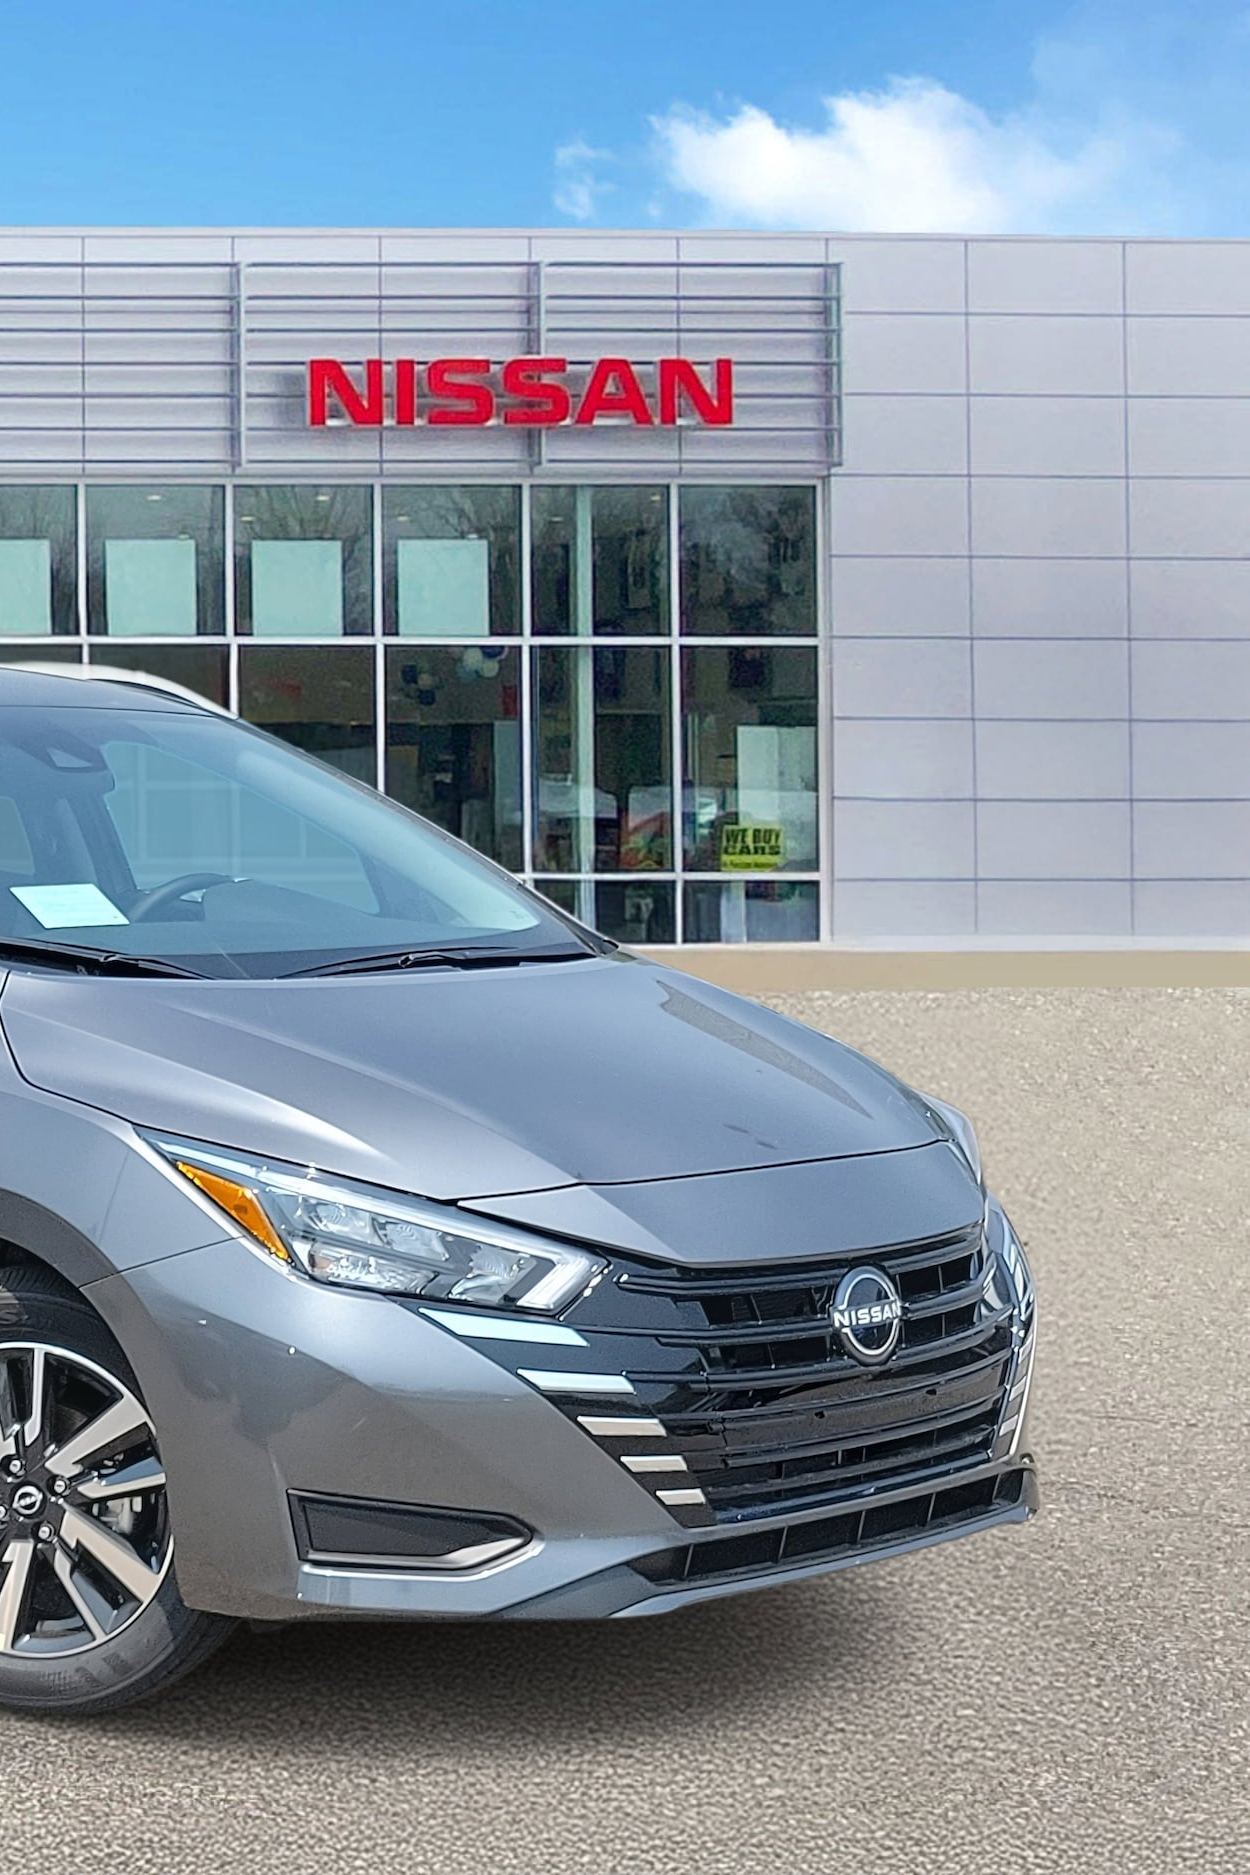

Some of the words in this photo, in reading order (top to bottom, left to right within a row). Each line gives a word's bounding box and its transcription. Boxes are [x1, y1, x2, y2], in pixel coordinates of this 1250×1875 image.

[308, 356, 734, 427] NISSAN
[724, 828, 748, 844] WE
[752, 828, 782, 844] BUY
[723, 844, 781, 856] CARS
[833, 1302, 902, 1328] NISSAN
